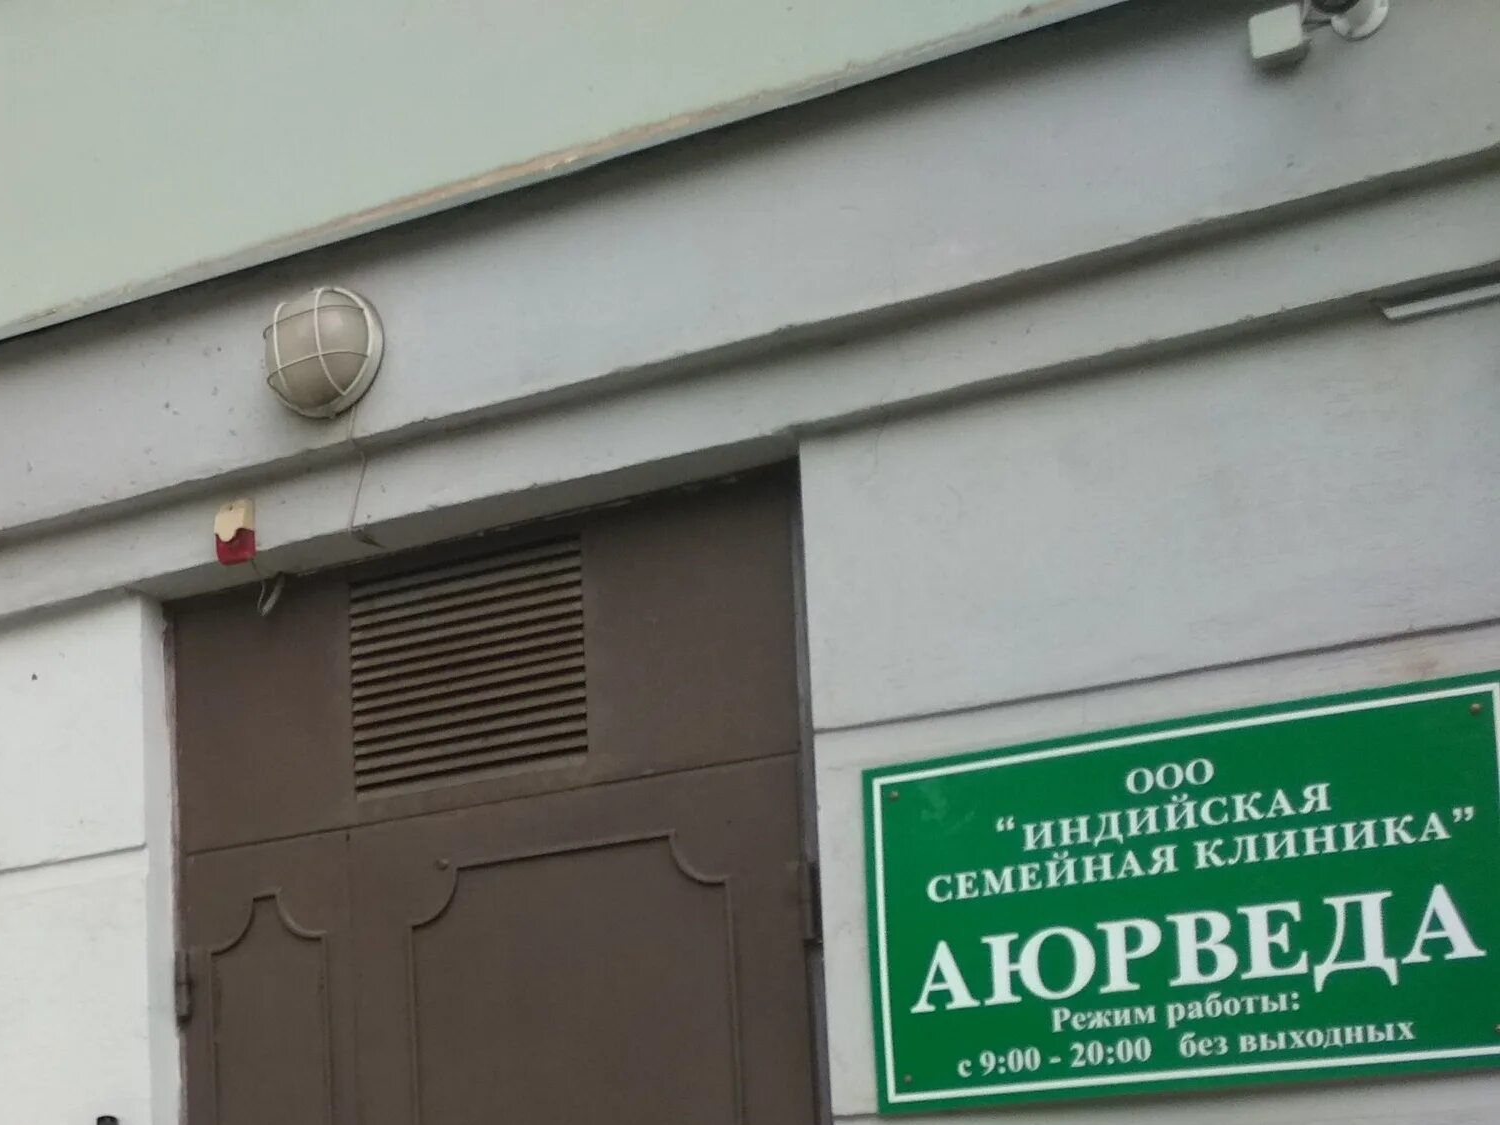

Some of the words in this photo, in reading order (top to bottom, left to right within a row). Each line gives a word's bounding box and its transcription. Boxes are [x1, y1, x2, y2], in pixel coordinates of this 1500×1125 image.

[1125, 757, 1215, 796] ООО
[927, 841, 1179, 904] СЕМЕЙНАЯ
[910, 883, 1486, 1014] АЮРВЕДА
[1051, 1001, 1156, 1034] Режим
[1166, 990, 1301, 1029] работы:
[958, 1058, 973, 1078] с
[981, 1045, 1041, 1075] 9:00
[1071, 1036, 1152, 1069] 20:00
[1179, 1030, 1228, 1059] без
[1239, 1019, 1415, 1055] выходных
